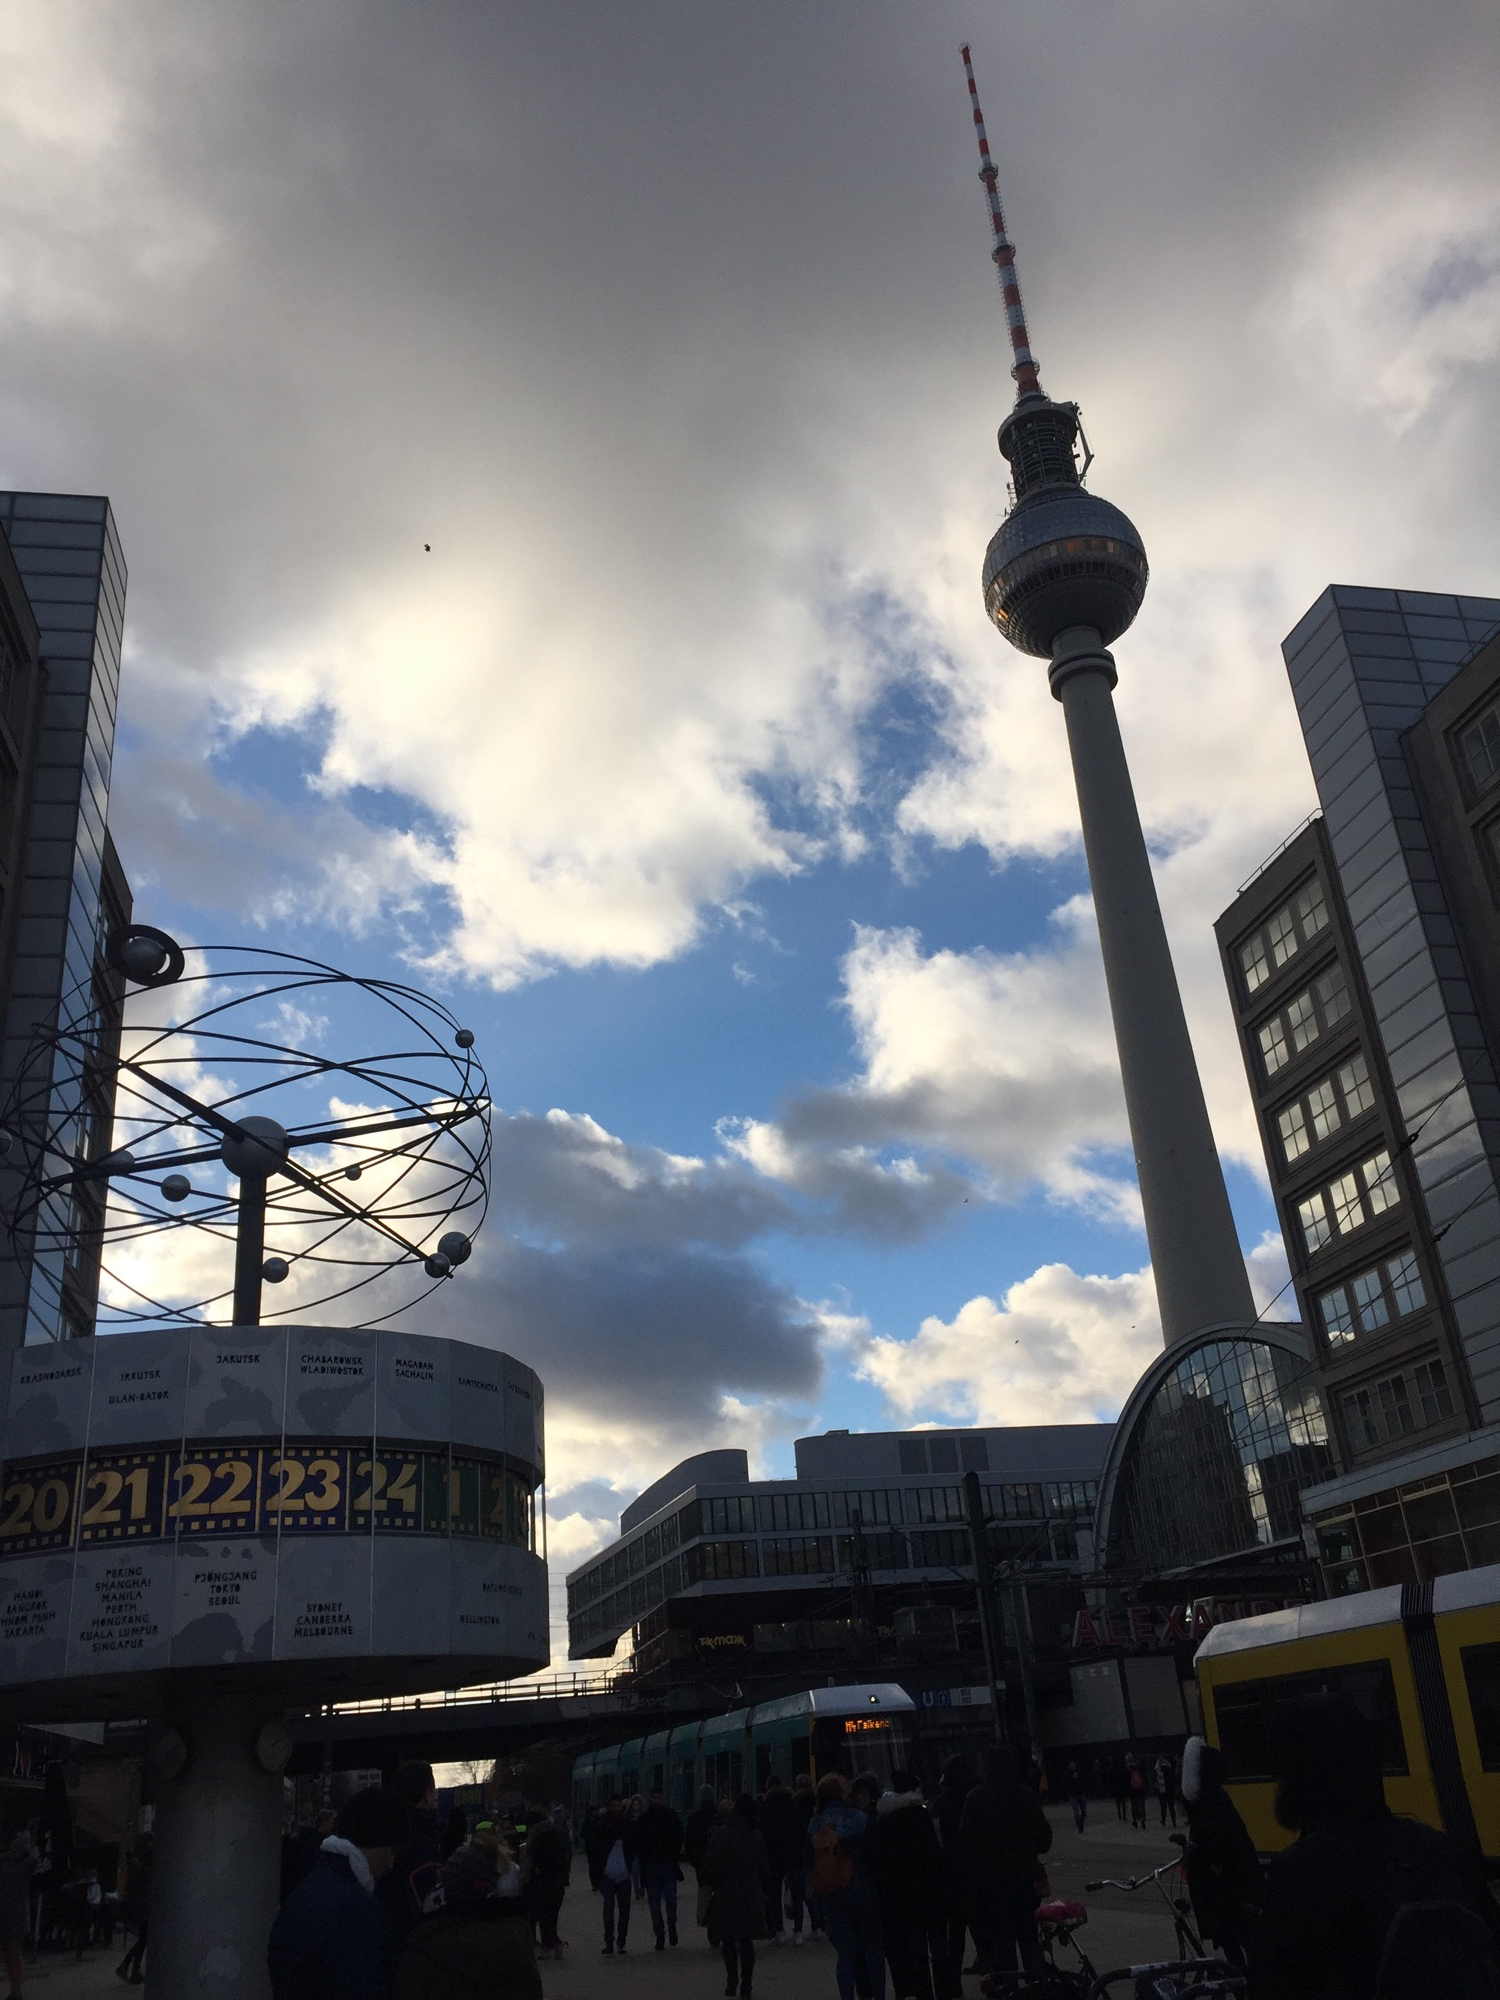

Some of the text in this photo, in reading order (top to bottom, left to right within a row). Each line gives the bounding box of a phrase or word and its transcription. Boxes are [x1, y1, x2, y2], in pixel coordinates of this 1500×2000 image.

[216, 1354, 260, 1364] JAKUTSK
[2, 1478, 71, 1534] 20
[82, 1468, 151, 1524] 21
[168, 1461, 257, 1517] 22
[265, 1459, 342, 1513] 23
[353, 1463, 417, 1512] 24
